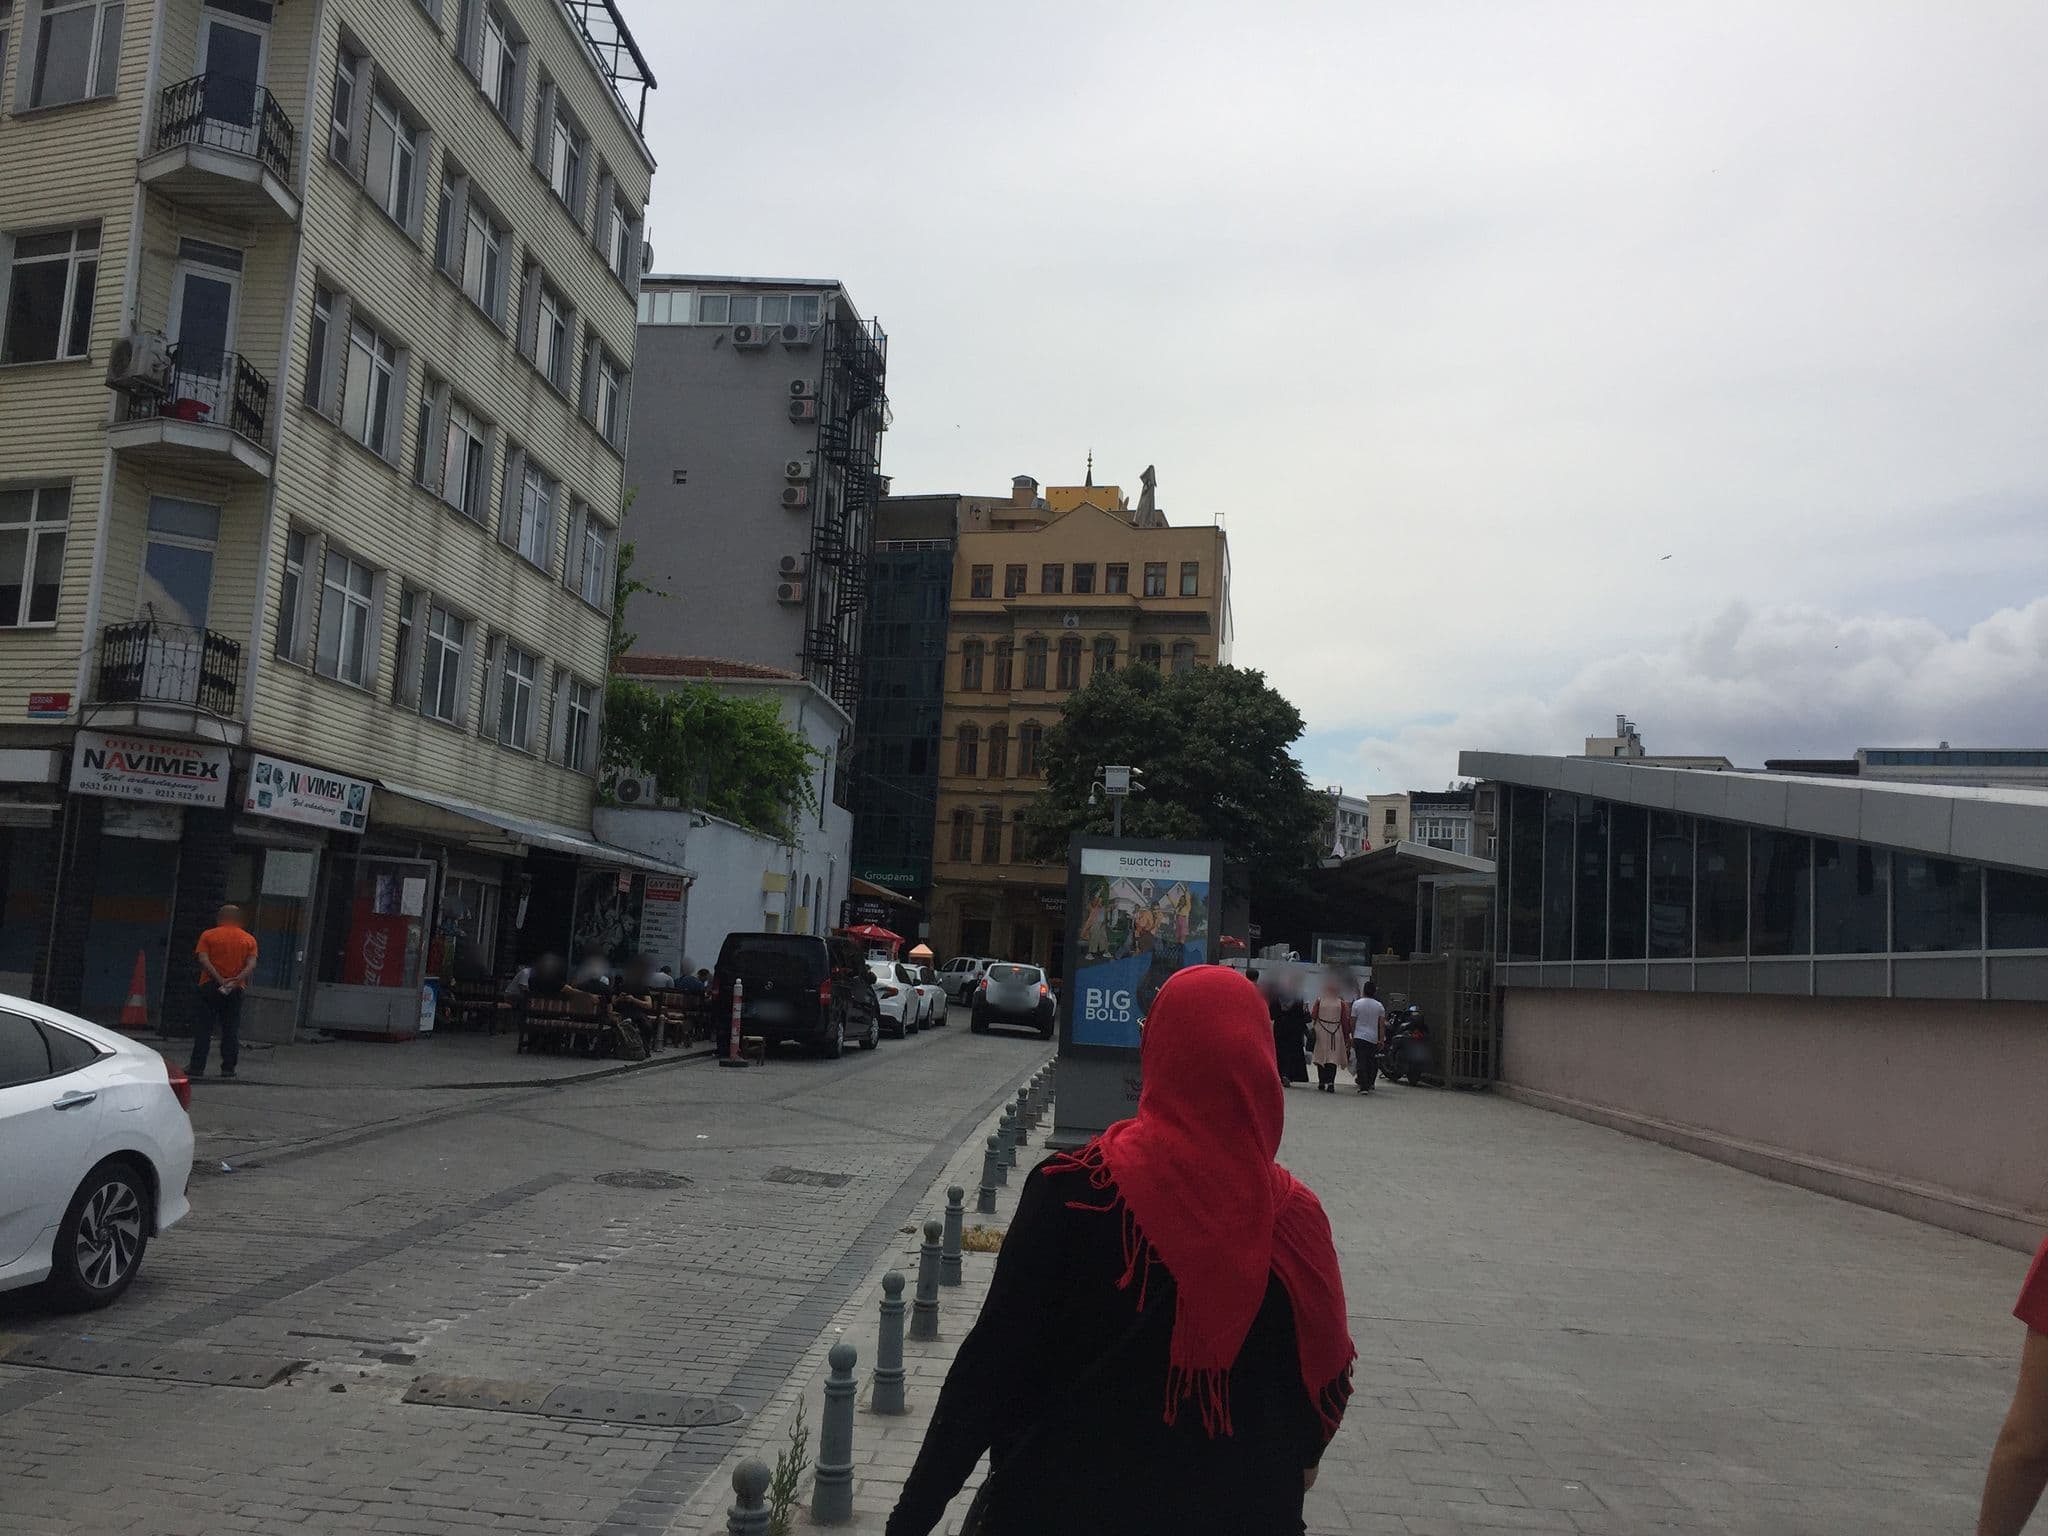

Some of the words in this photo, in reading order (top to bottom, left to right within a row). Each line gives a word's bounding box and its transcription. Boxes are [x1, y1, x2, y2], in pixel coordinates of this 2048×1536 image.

[83, 748, 219, 779] NAVIMEX
[288, 771, 347, 800] NAVIMEX
[1119, 857, 1162, 867] swatch
[864, 871, 914, 882] Groupama
[1086, 988, 1131, 1010] BIG
[1085, 1008, 1130, 1022] BOLD
